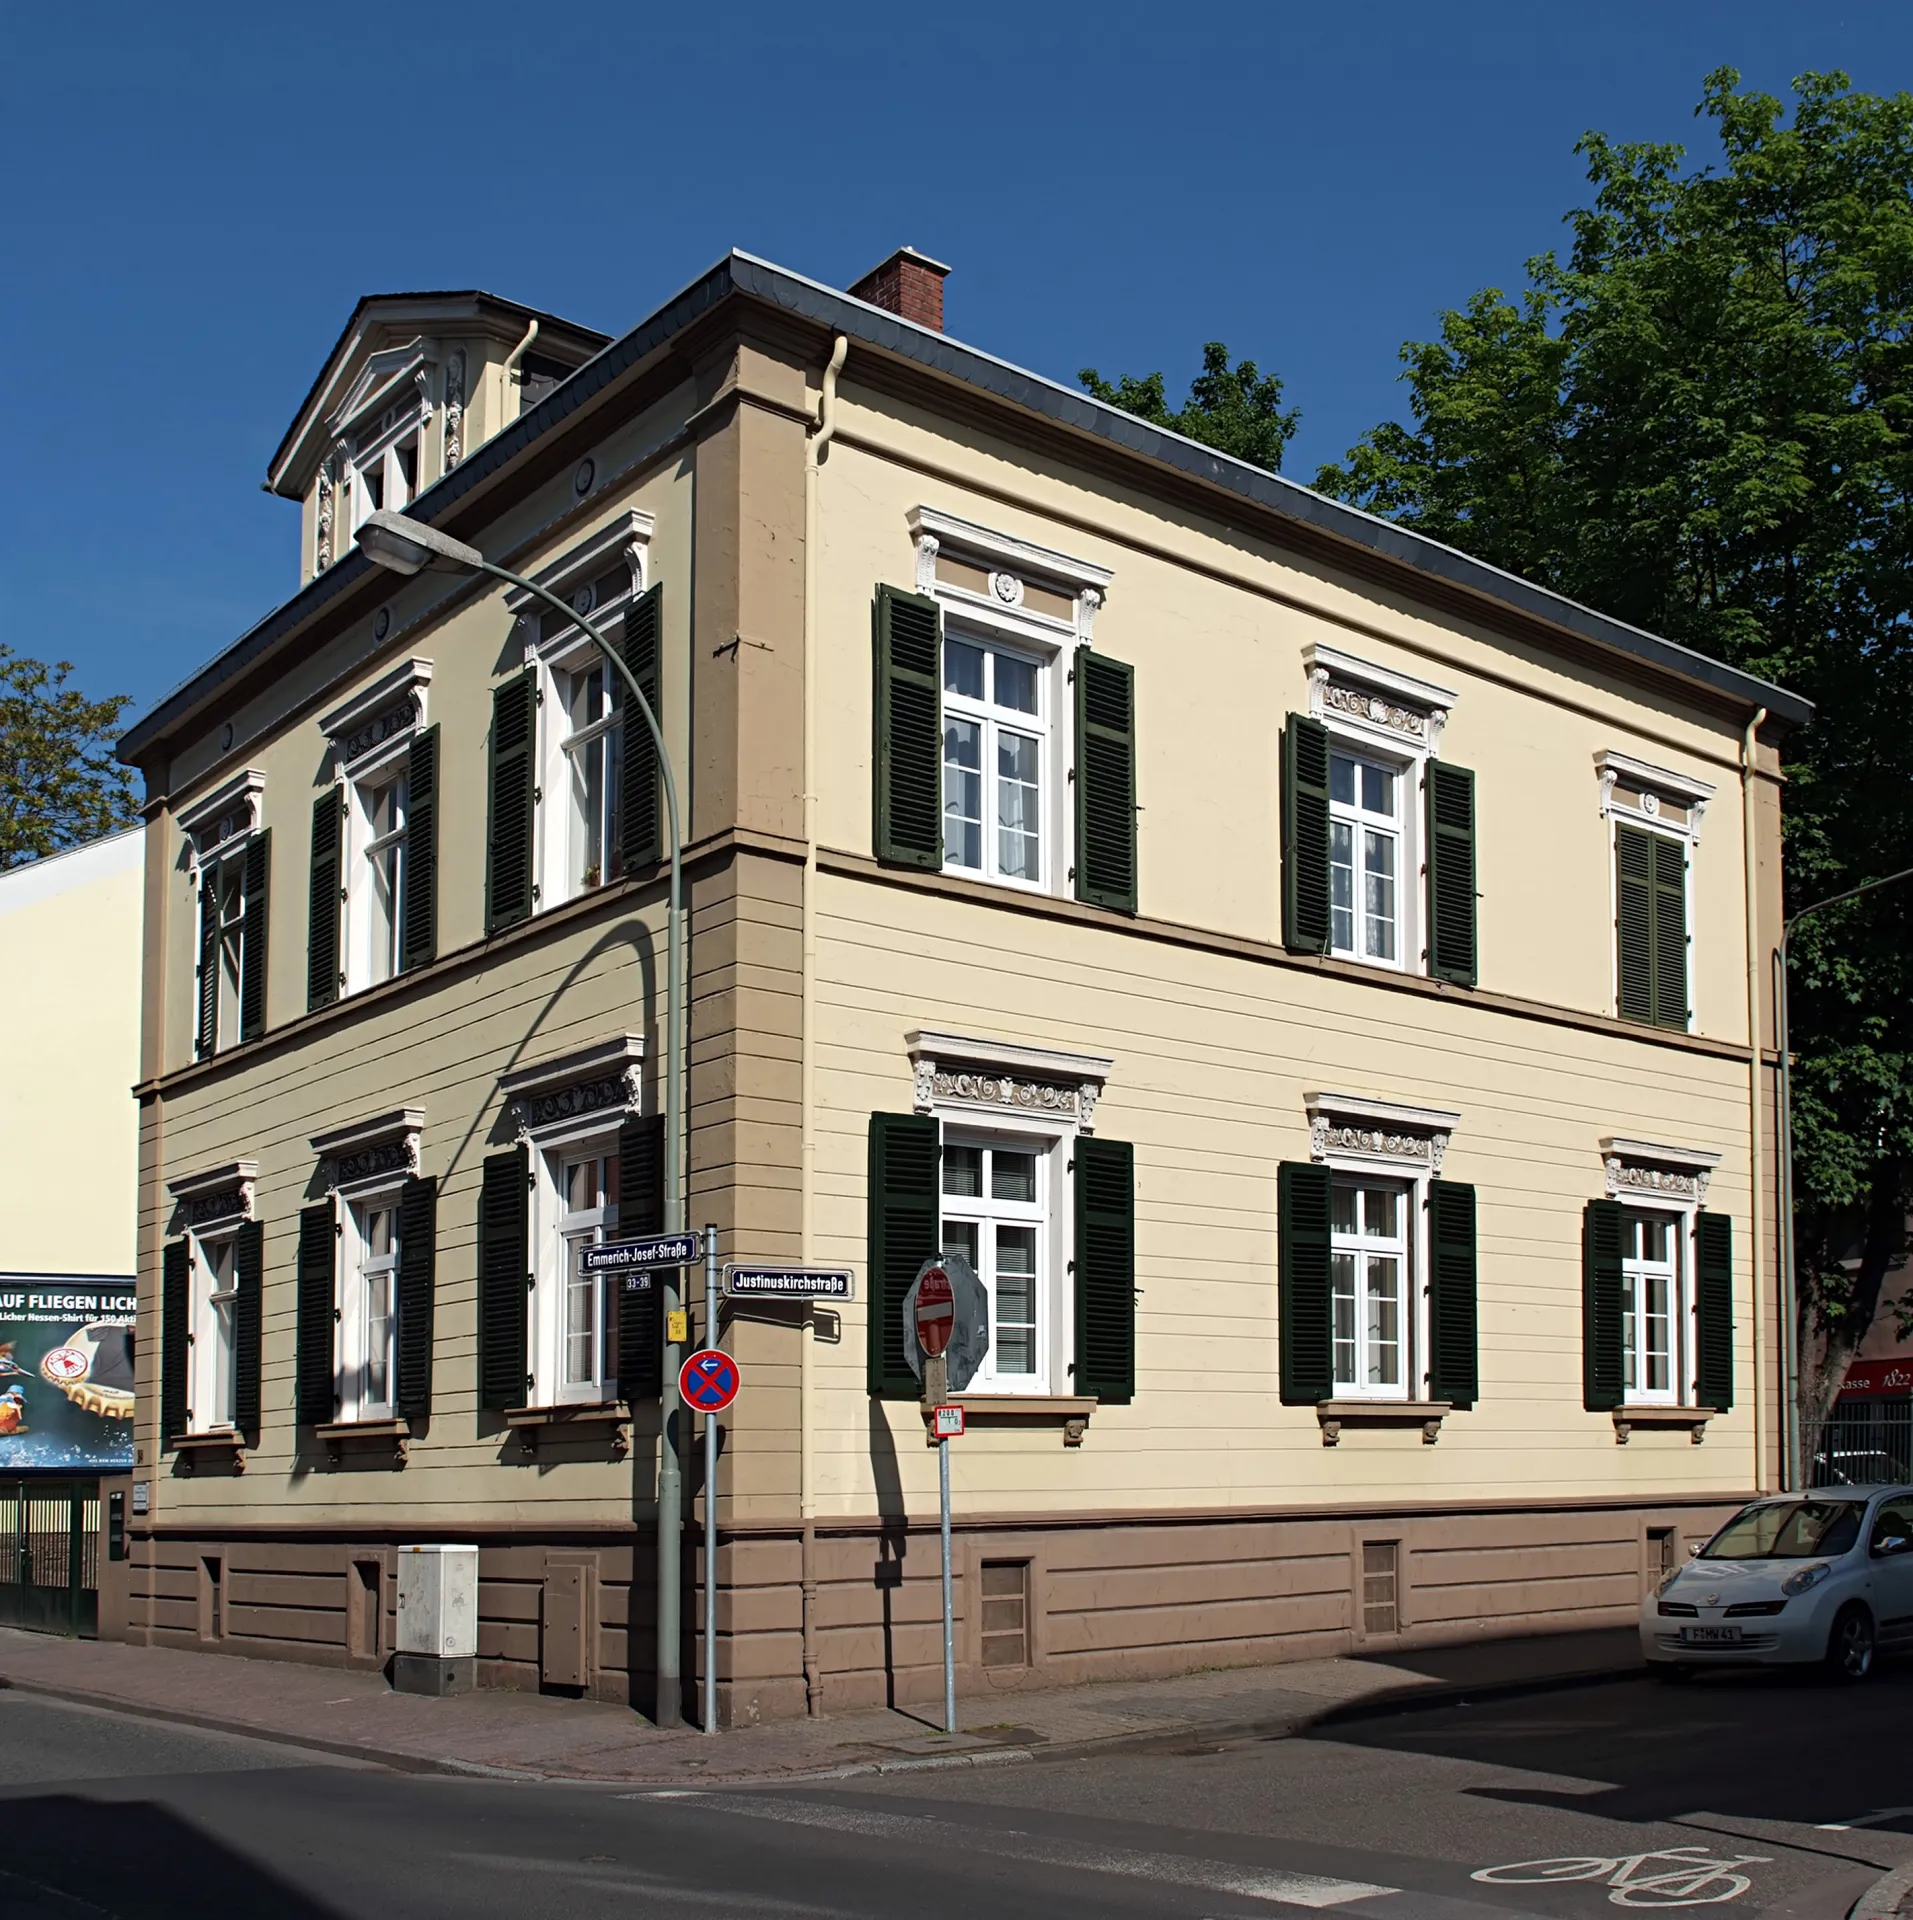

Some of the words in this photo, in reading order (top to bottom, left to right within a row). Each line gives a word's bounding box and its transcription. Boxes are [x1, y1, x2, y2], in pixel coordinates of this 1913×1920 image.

[587, 1242, 687, 1267] Emmerich-Josef-Straße
[627, 1277, 649, 1289] 33-39
[736, 1273, 844, 1293] Justinuskirchstraße
[29, 1294, 97, 1309] FLIEGEN
[101, 1296, 137, 1310] LICH
[0, 1312, 26, 1321] Licher
[28, 1313, 83, 1322] Hessen-Shirt
[85, 1313, 98, 1322] für
[1882, 1368, 1911, 1387] 1822
